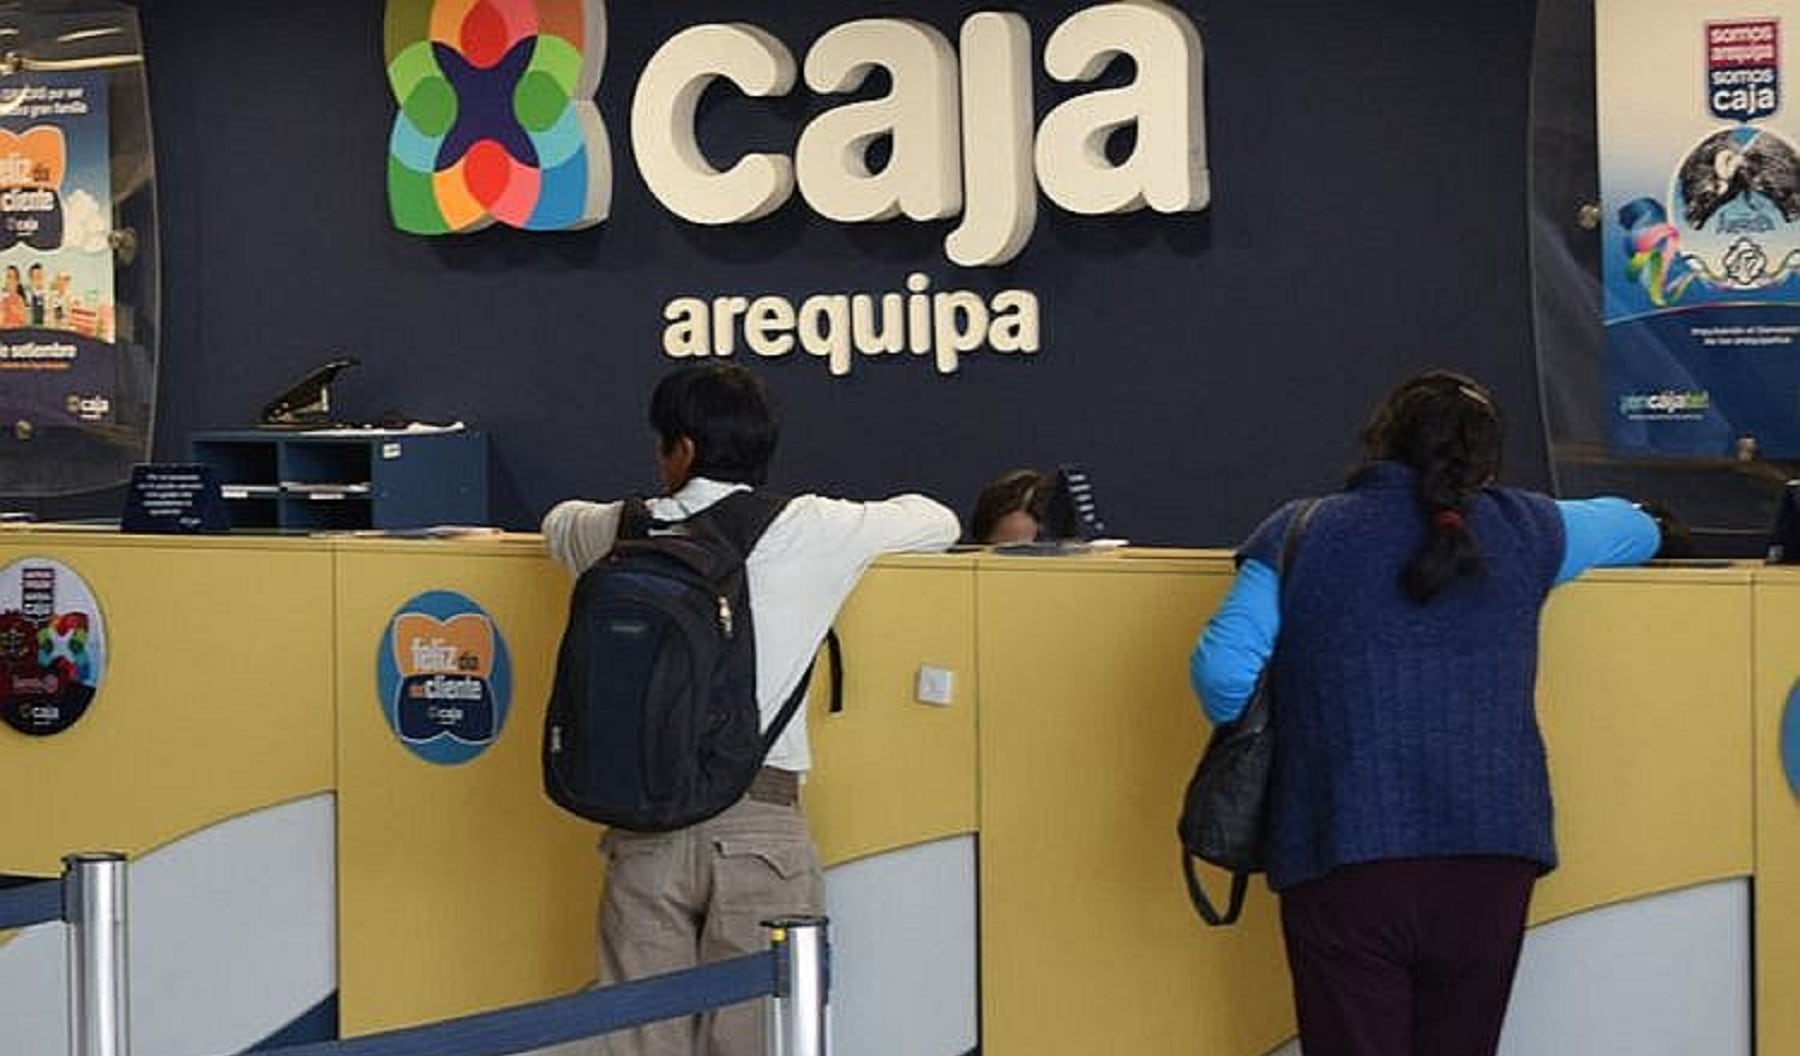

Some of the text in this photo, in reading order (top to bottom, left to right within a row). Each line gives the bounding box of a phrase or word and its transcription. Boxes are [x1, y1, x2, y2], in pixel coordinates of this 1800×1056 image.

[1709, 27, 1774, 43] somos
[1711, 67, 1774, 85] somos
[1712, 83, 1776, 114] caja
[630, 2, 1211, 267] caja
[2, 187, 55, 212] cliente
[661, 273, 1041, 375] arequipa
[424, 675, 482, 699] cliente
